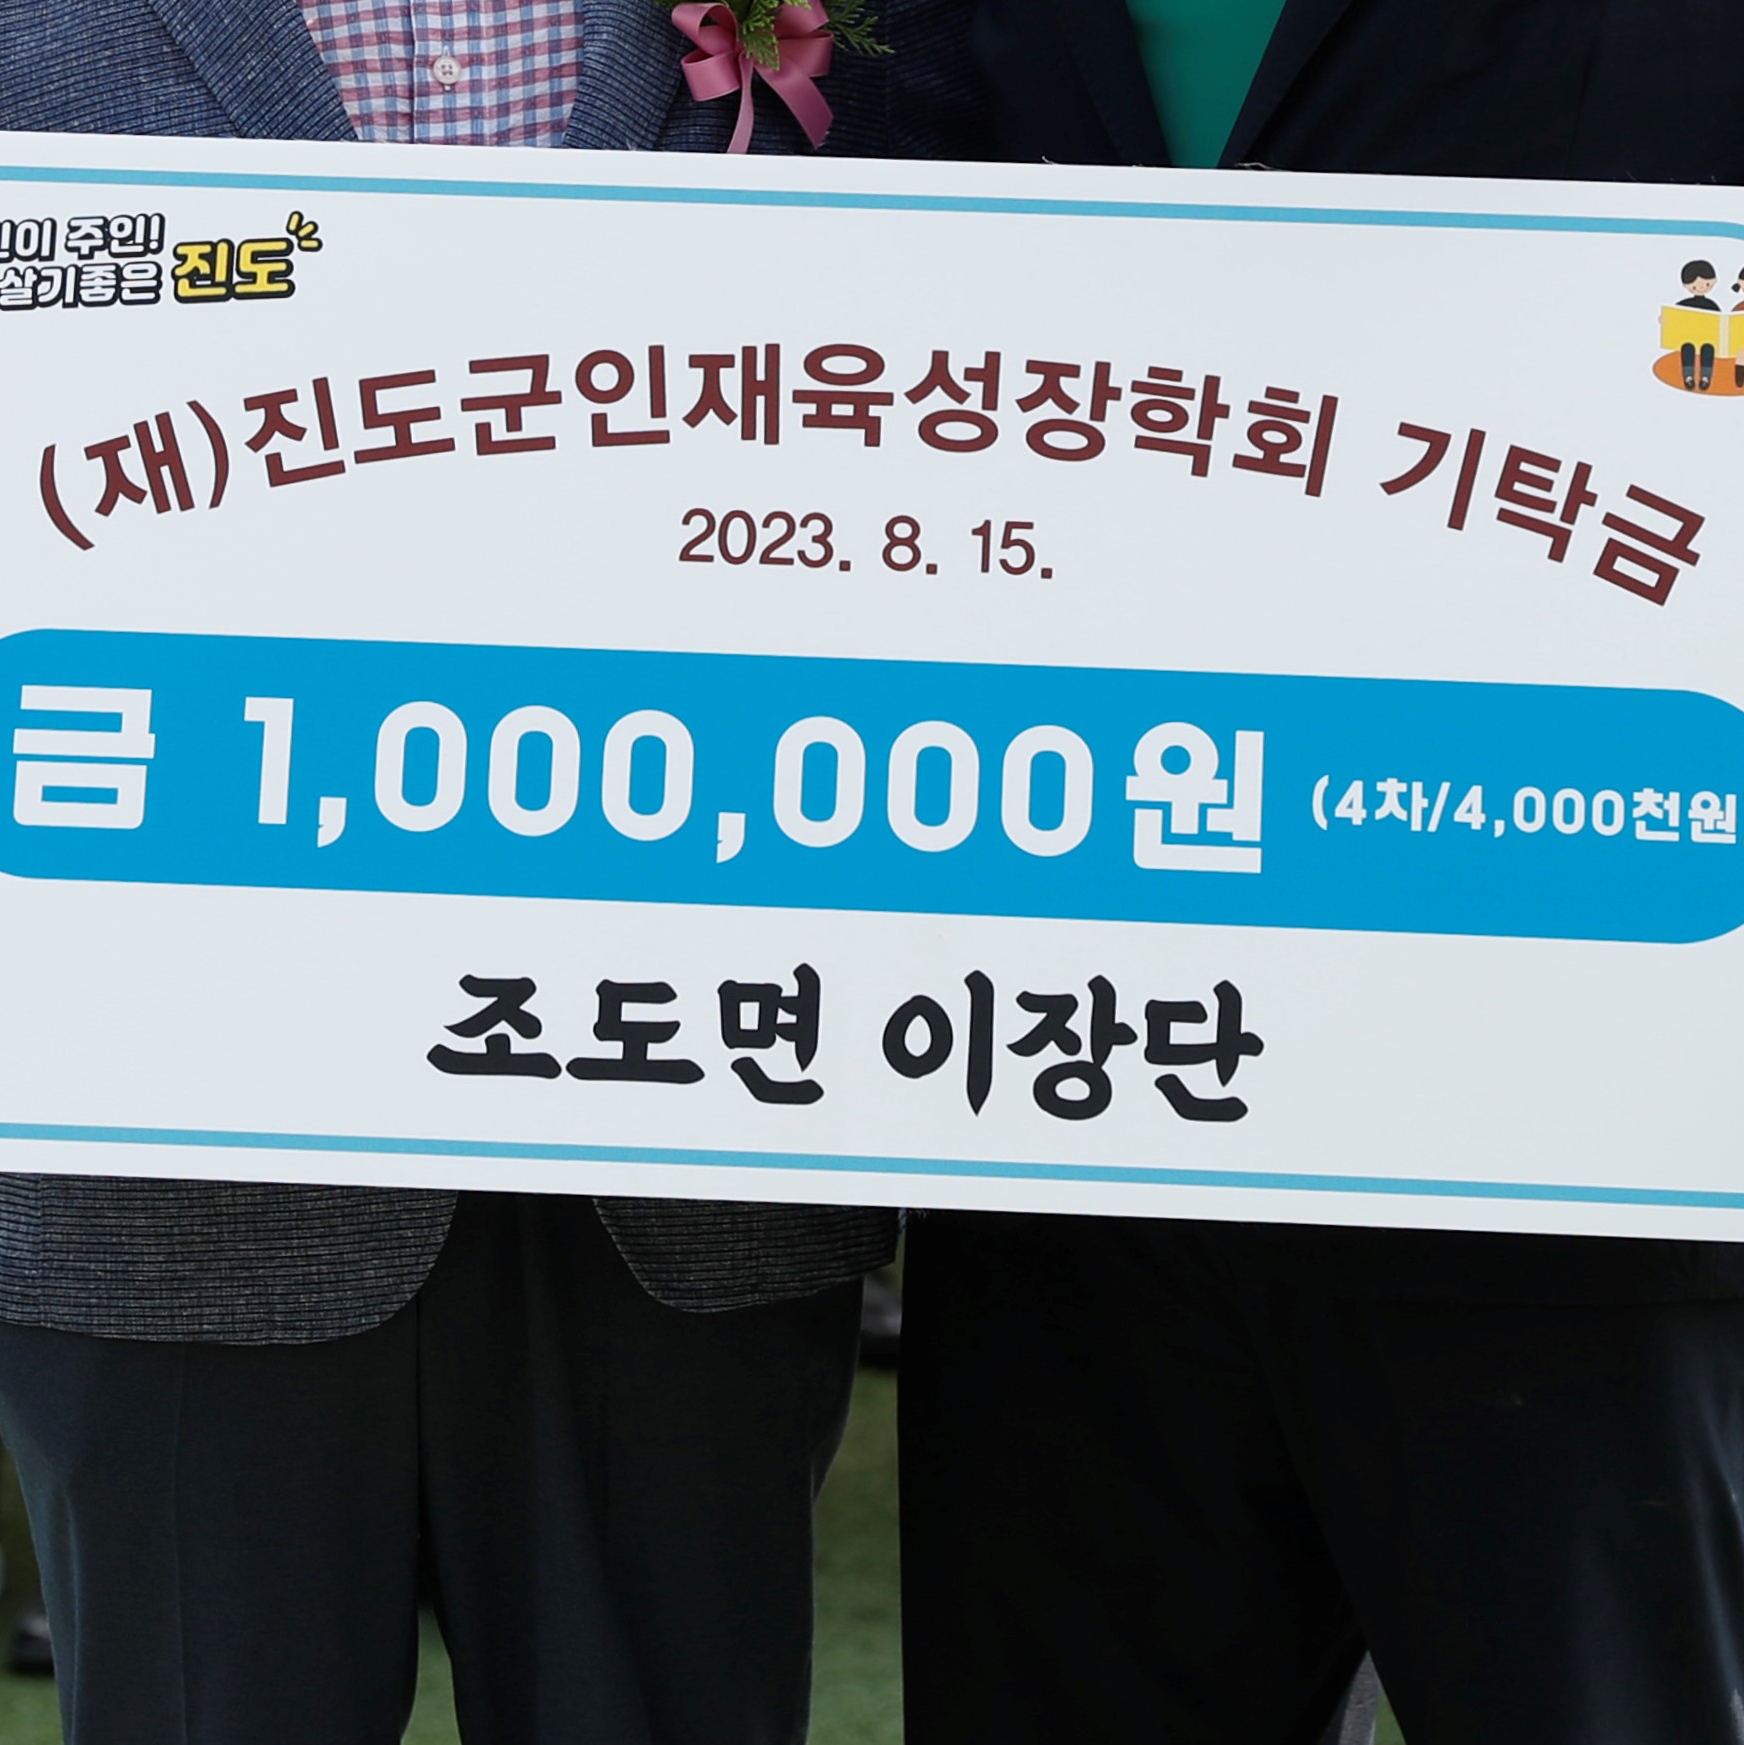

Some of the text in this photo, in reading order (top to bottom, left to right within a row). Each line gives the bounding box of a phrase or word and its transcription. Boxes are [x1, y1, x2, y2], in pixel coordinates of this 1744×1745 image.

[65, 213, 165, 259] 주인!
[172, 239, 296, 304] 진도
[39, 343, 1706, 607] (재)진도군인재육성장학회 기탁금
[678, 507, 1053, 580] 2023. 8. 15.
[12, 684, 156, 830] 금
[244, 696, 1265, 874] 1,000,000원
[426, 962, 1265, 1123] 조도면 이장단
